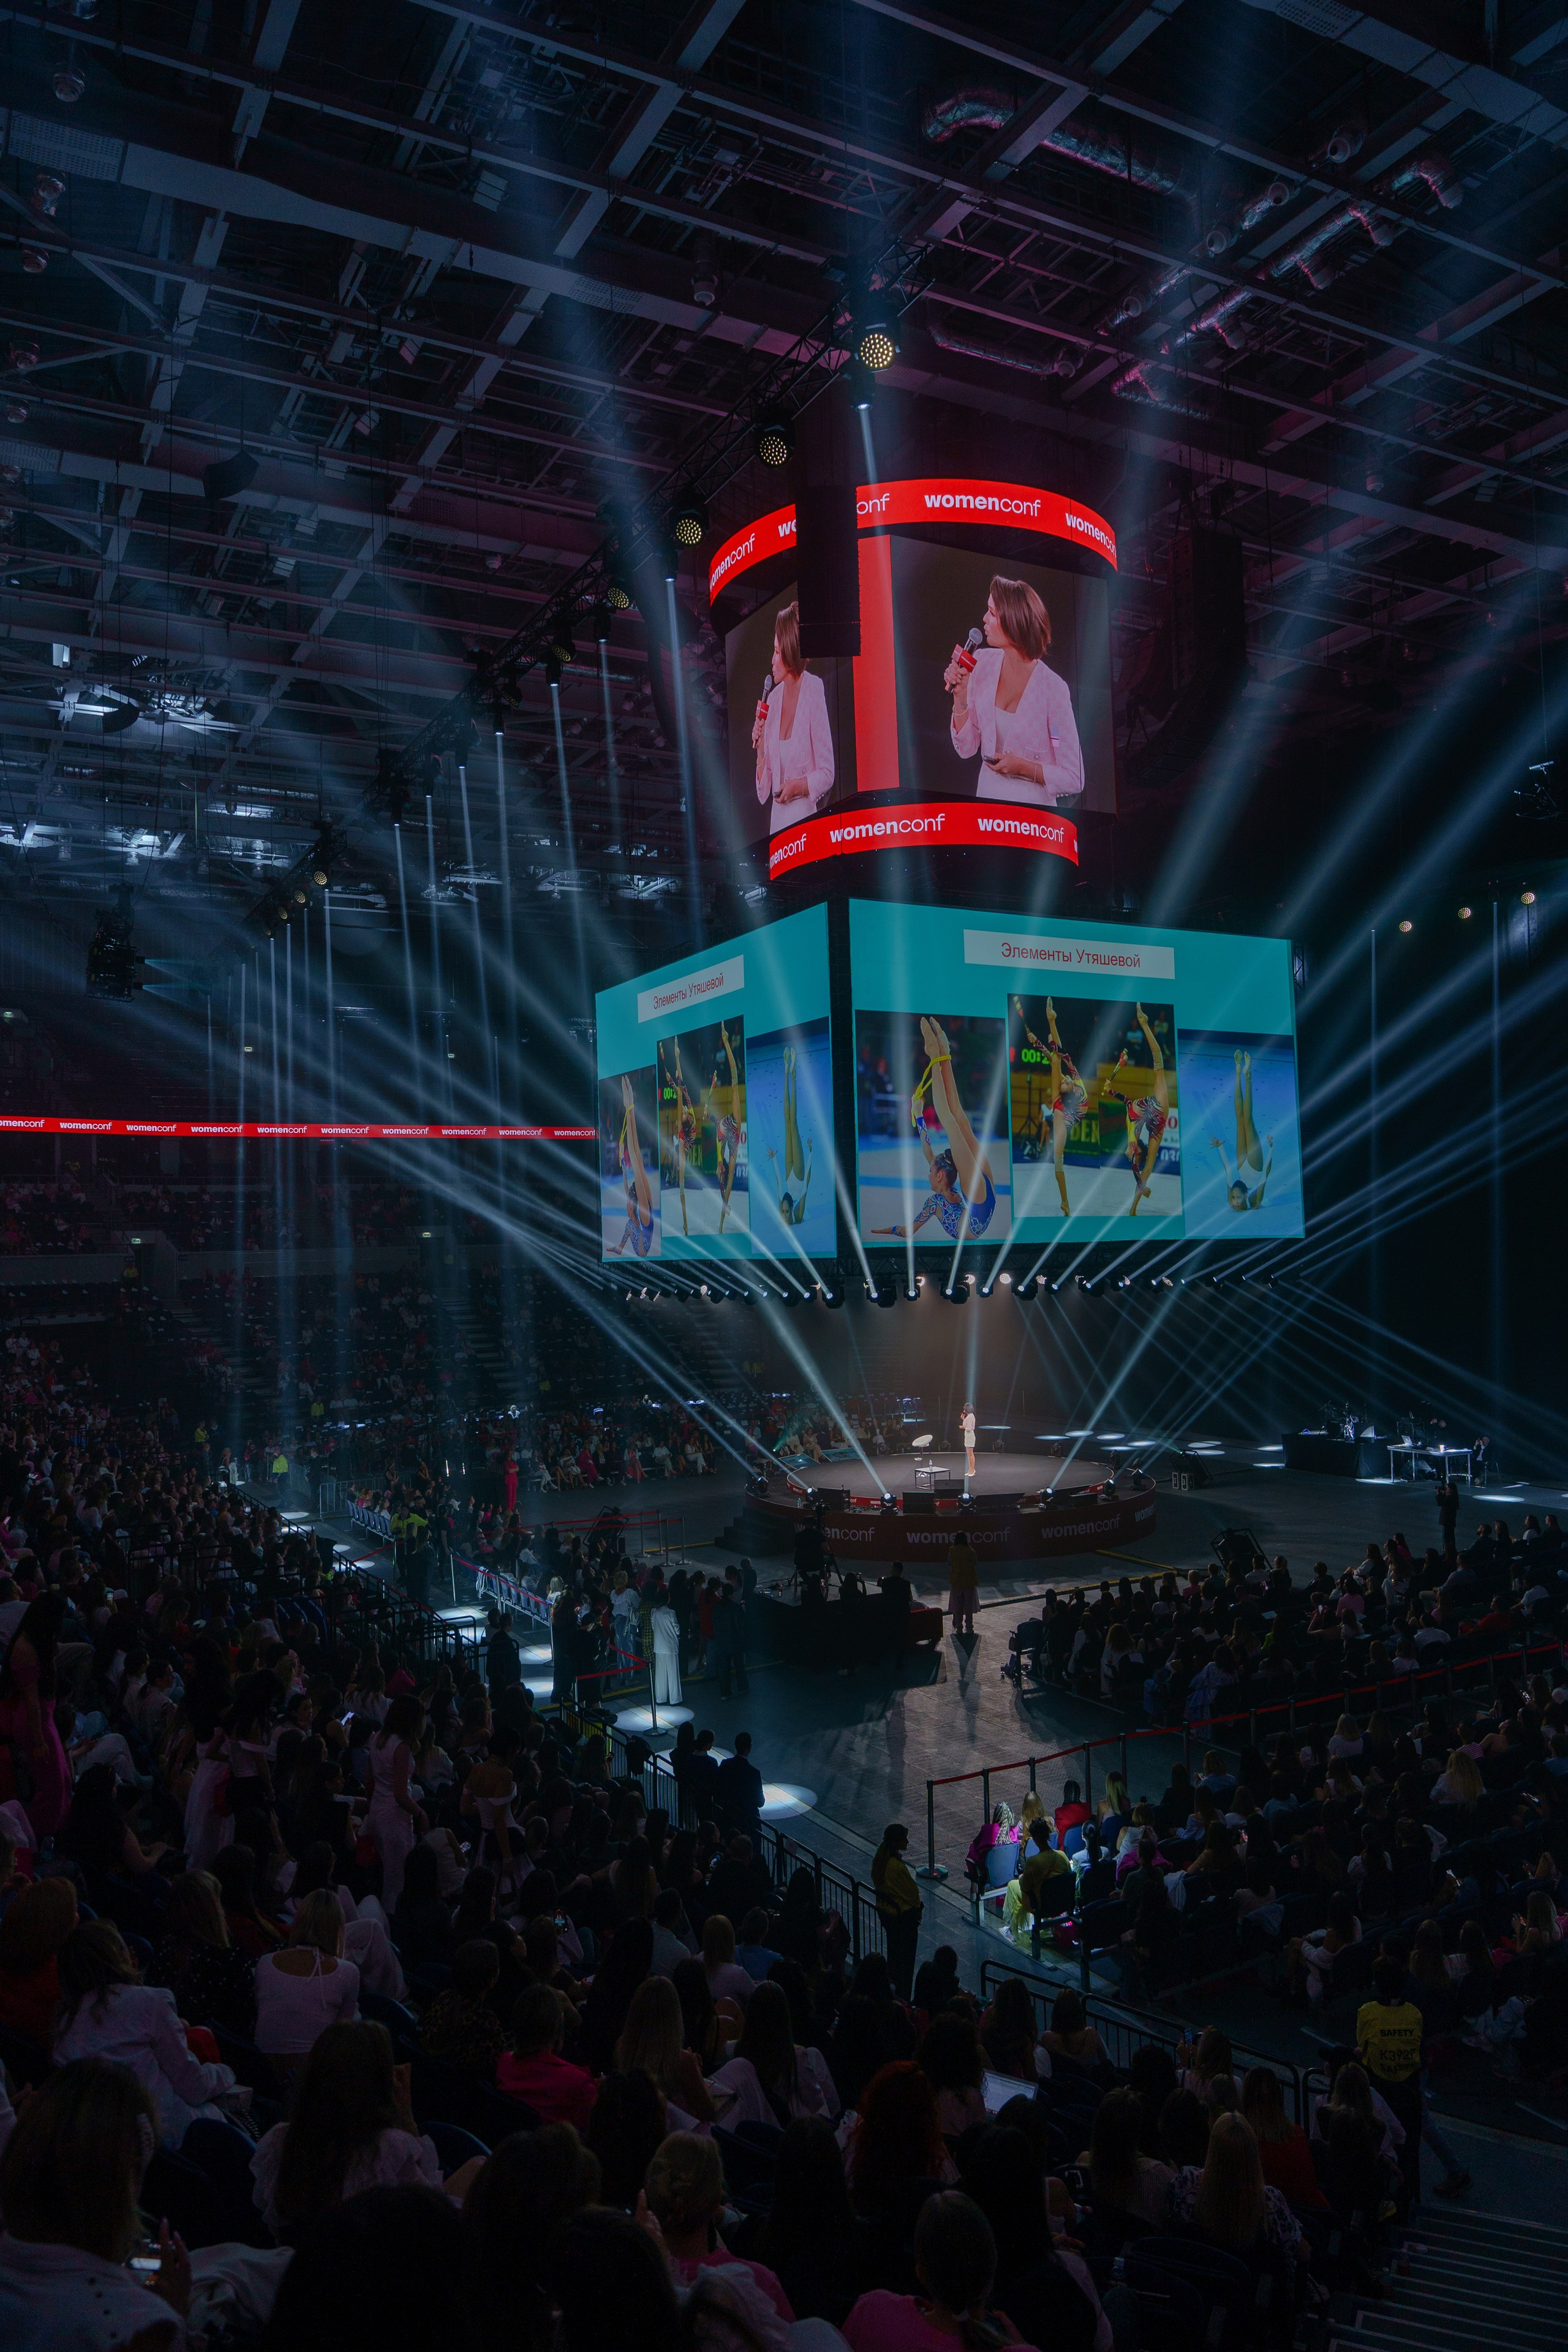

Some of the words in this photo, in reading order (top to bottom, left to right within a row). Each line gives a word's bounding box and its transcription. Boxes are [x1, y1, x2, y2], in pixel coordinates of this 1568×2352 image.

[924, 494, 1041, 517] womenconf
[1065, 513, 1117, 559] womencon
[830, 813, 946, 843] womenconf
[978, 818, 1064, 843] womenconf
[1001, 943, 1072, 963] Элементы
[1076, 949, 1140, 968] Утяшевой
[654, 989, 687, 1009] Элементы
[688, 972, 723, 998] Утяшевой
[1041, 1513, 1120, 1539] womenconf
